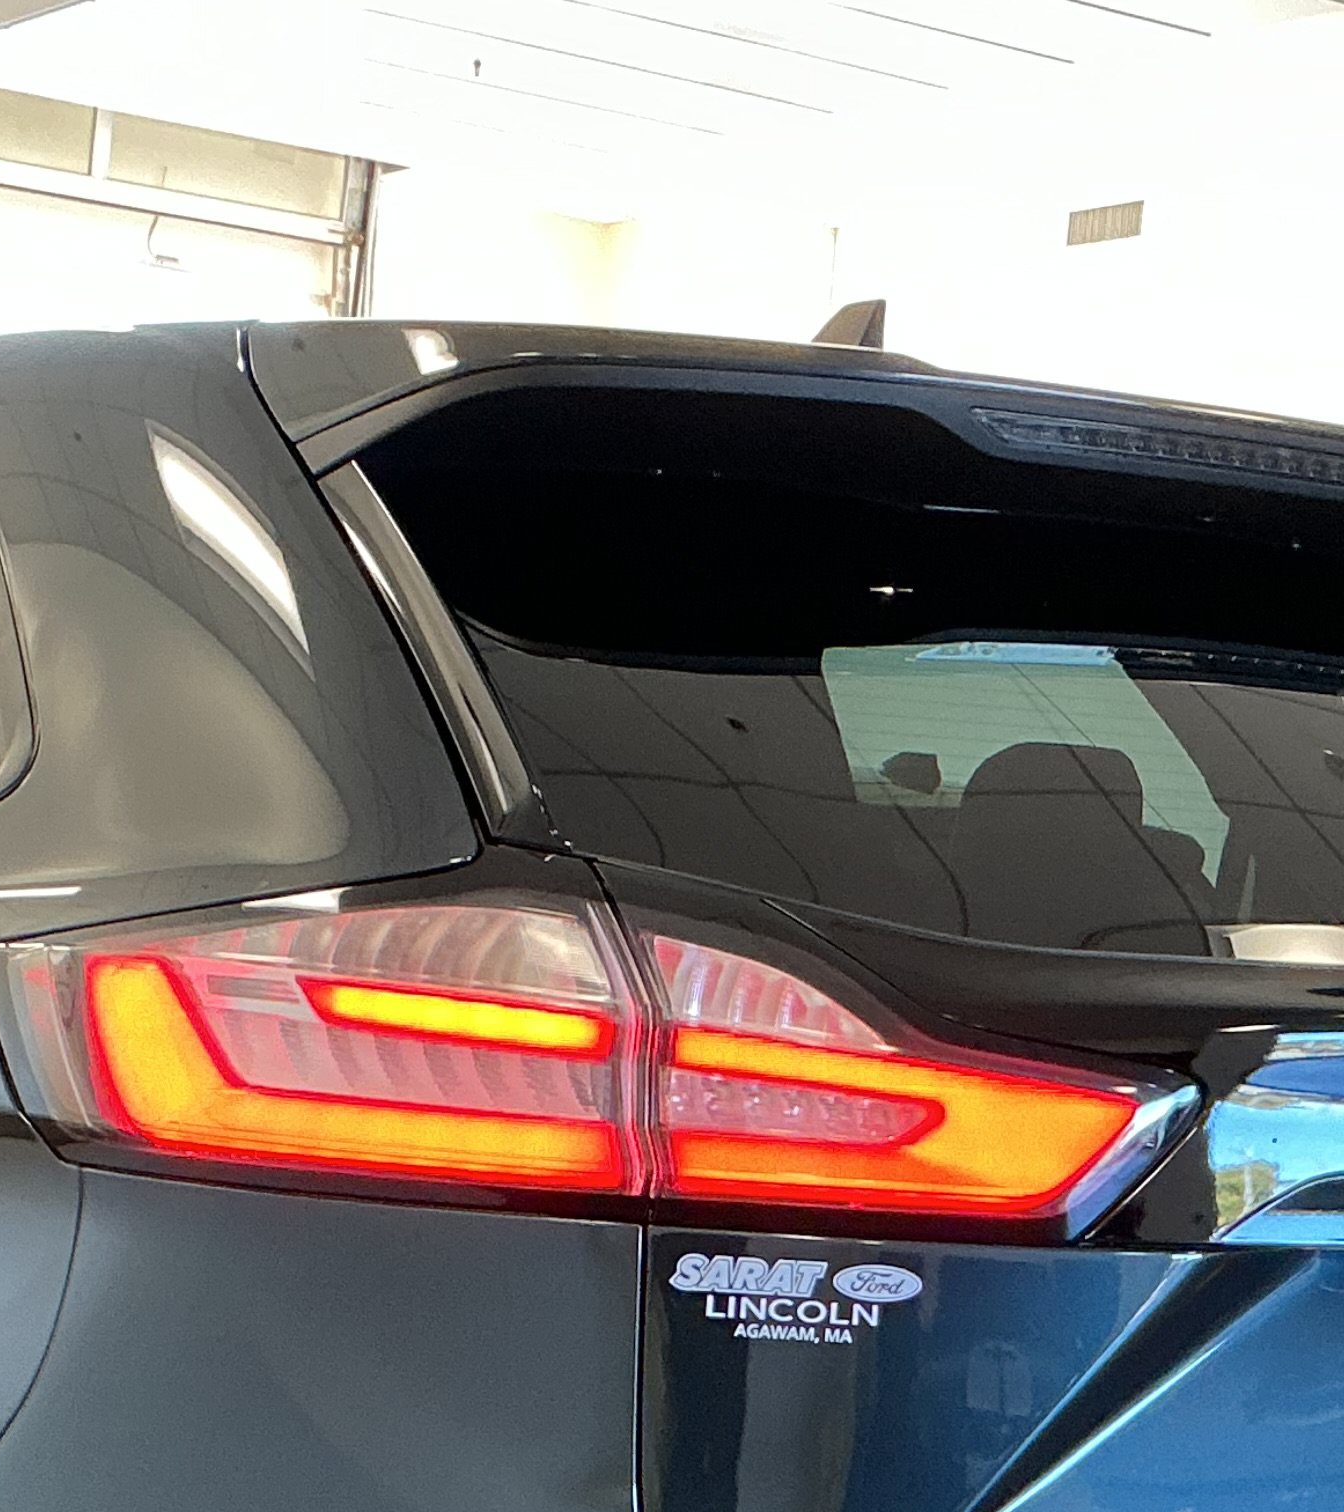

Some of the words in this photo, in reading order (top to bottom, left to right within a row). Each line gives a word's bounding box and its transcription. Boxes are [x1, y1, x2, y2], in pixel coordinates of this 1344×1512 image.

[669, 1252, 829, 1298] SARAT
[704, 1294, 881, 1328] LINCOLN
[733, 1323, 820, 1345] AGAWAM,
[824, 1327, 854, 1345] MA
